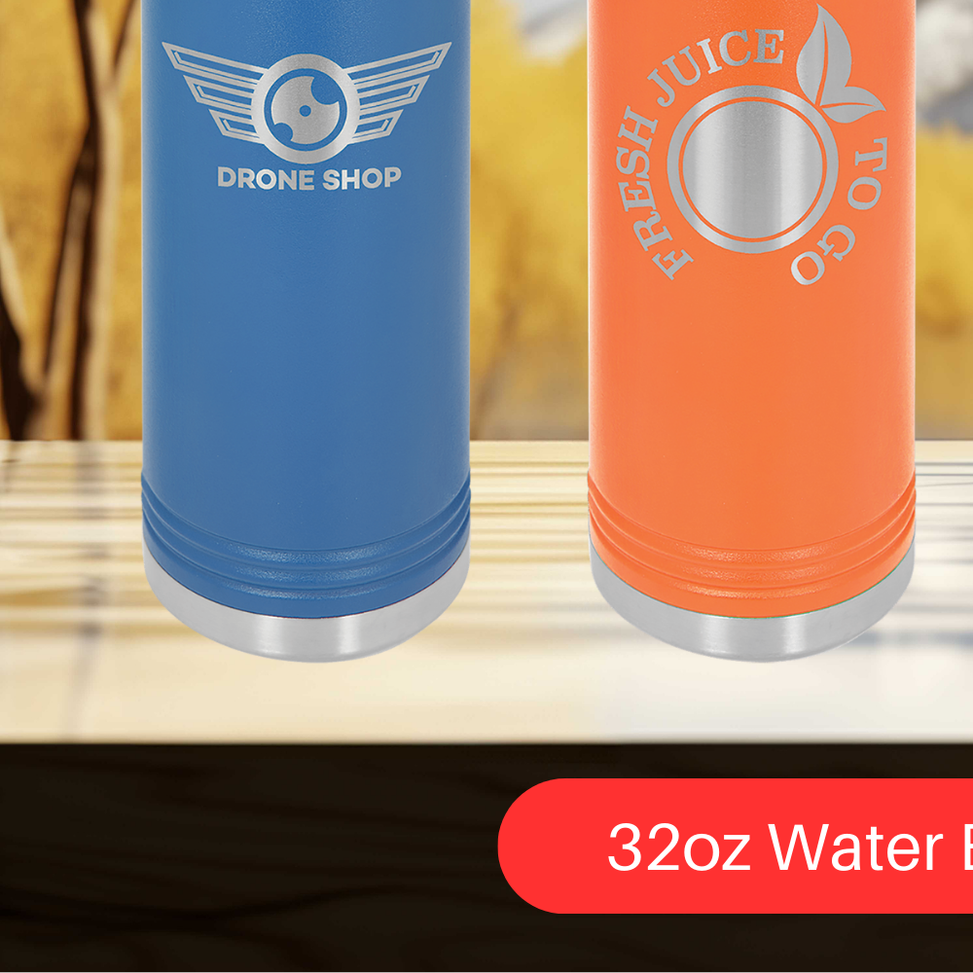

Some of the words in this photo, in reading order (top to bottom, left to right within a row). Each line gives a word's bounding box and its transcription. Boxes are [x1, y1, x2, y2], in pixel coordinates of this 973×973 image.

[646, 28, 785, 108] JUICE
[217, 166, 315, 191] DRONE
[322, 166, 402, 191] SHOP
[615, 104, 695, 281] FRESH
[846, 136, 888, 211] TO
[790, 224, 856, 286] GO
